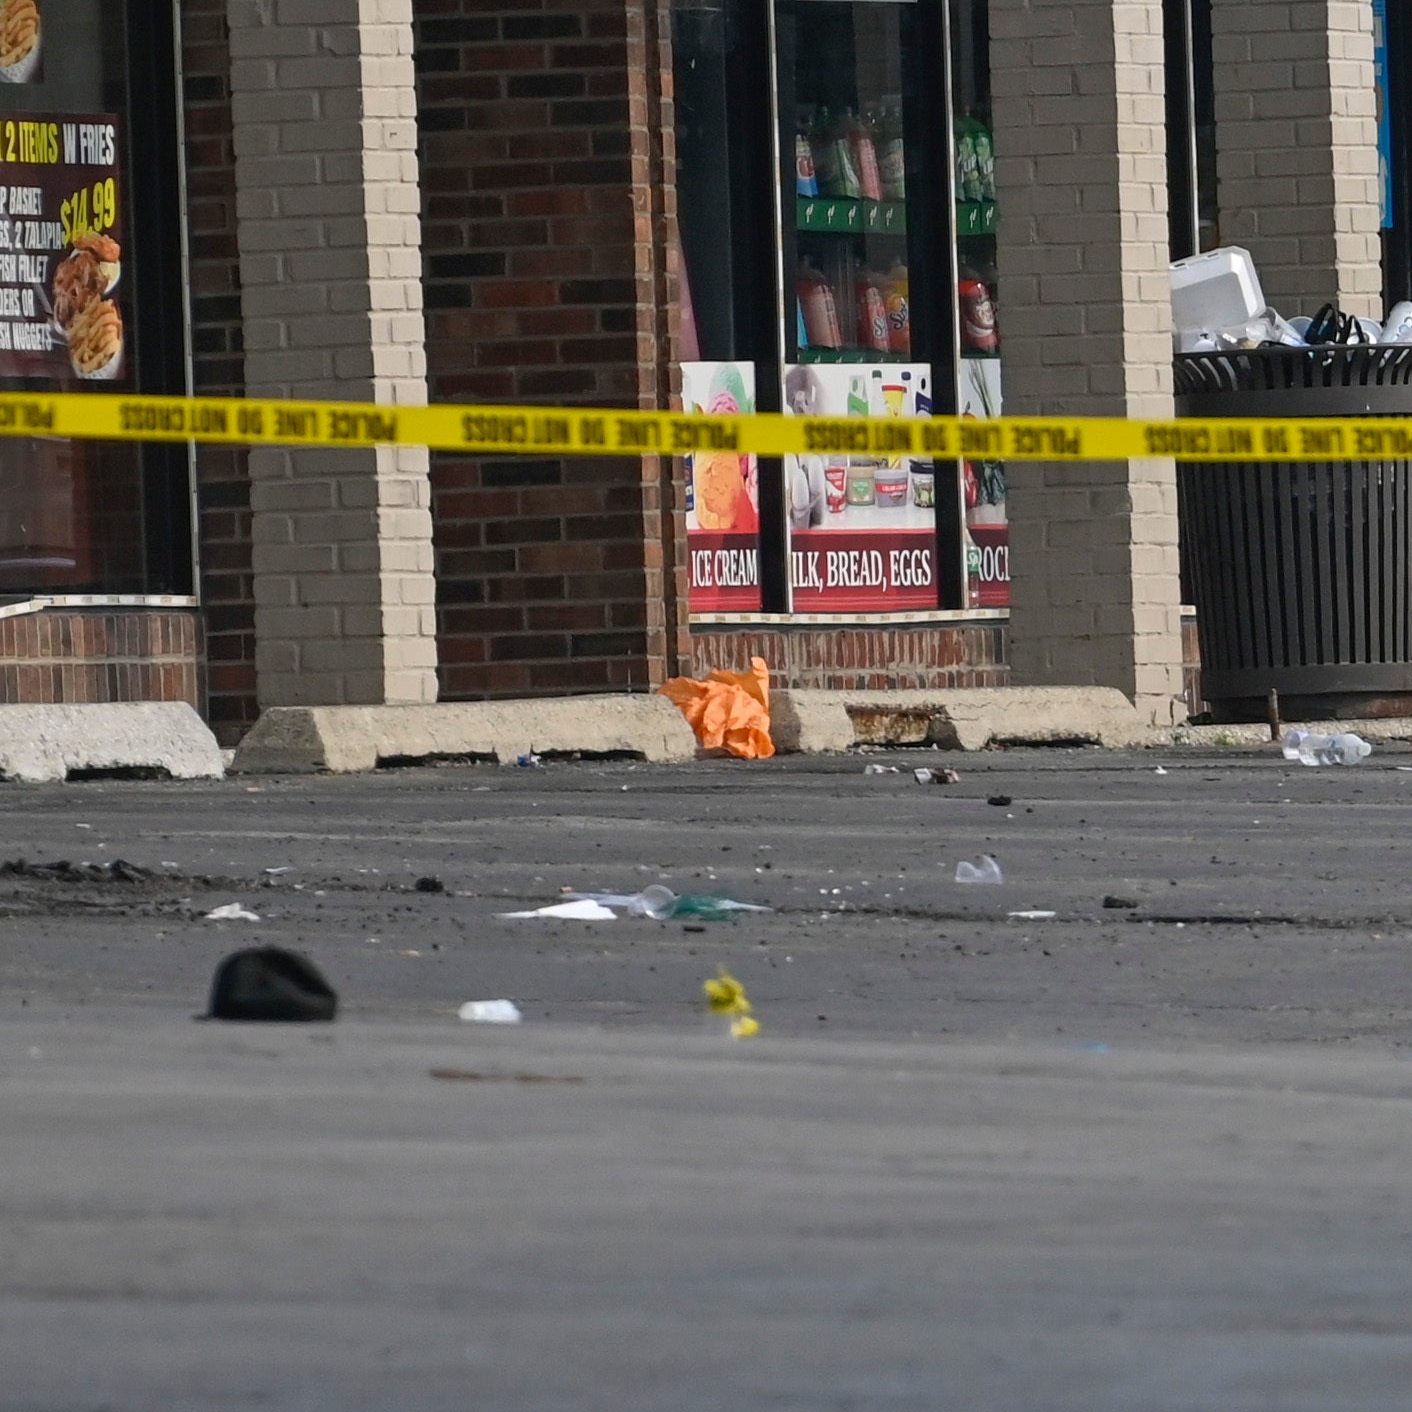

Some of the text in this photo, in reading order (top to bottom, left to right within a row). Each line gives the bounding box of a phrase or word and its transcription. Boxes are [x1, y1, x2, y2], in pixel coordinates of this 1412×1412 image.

[19, 121, 59, 164] ITEMS
[62, 123, 76, 164] W
[79, 124, 115, 166] FRIES
[9, 187, 42, 216] BASKET
[60, 177, 116, 250] $14.99
[0, 402, 54, 428] POLIC
[691, 549, 758, 587] ICE CREAM
[792, 550, 823, 593] ILK,
[826, 550, 887, 592] BREAD,
[890, 549, 932, 586] EGGS
